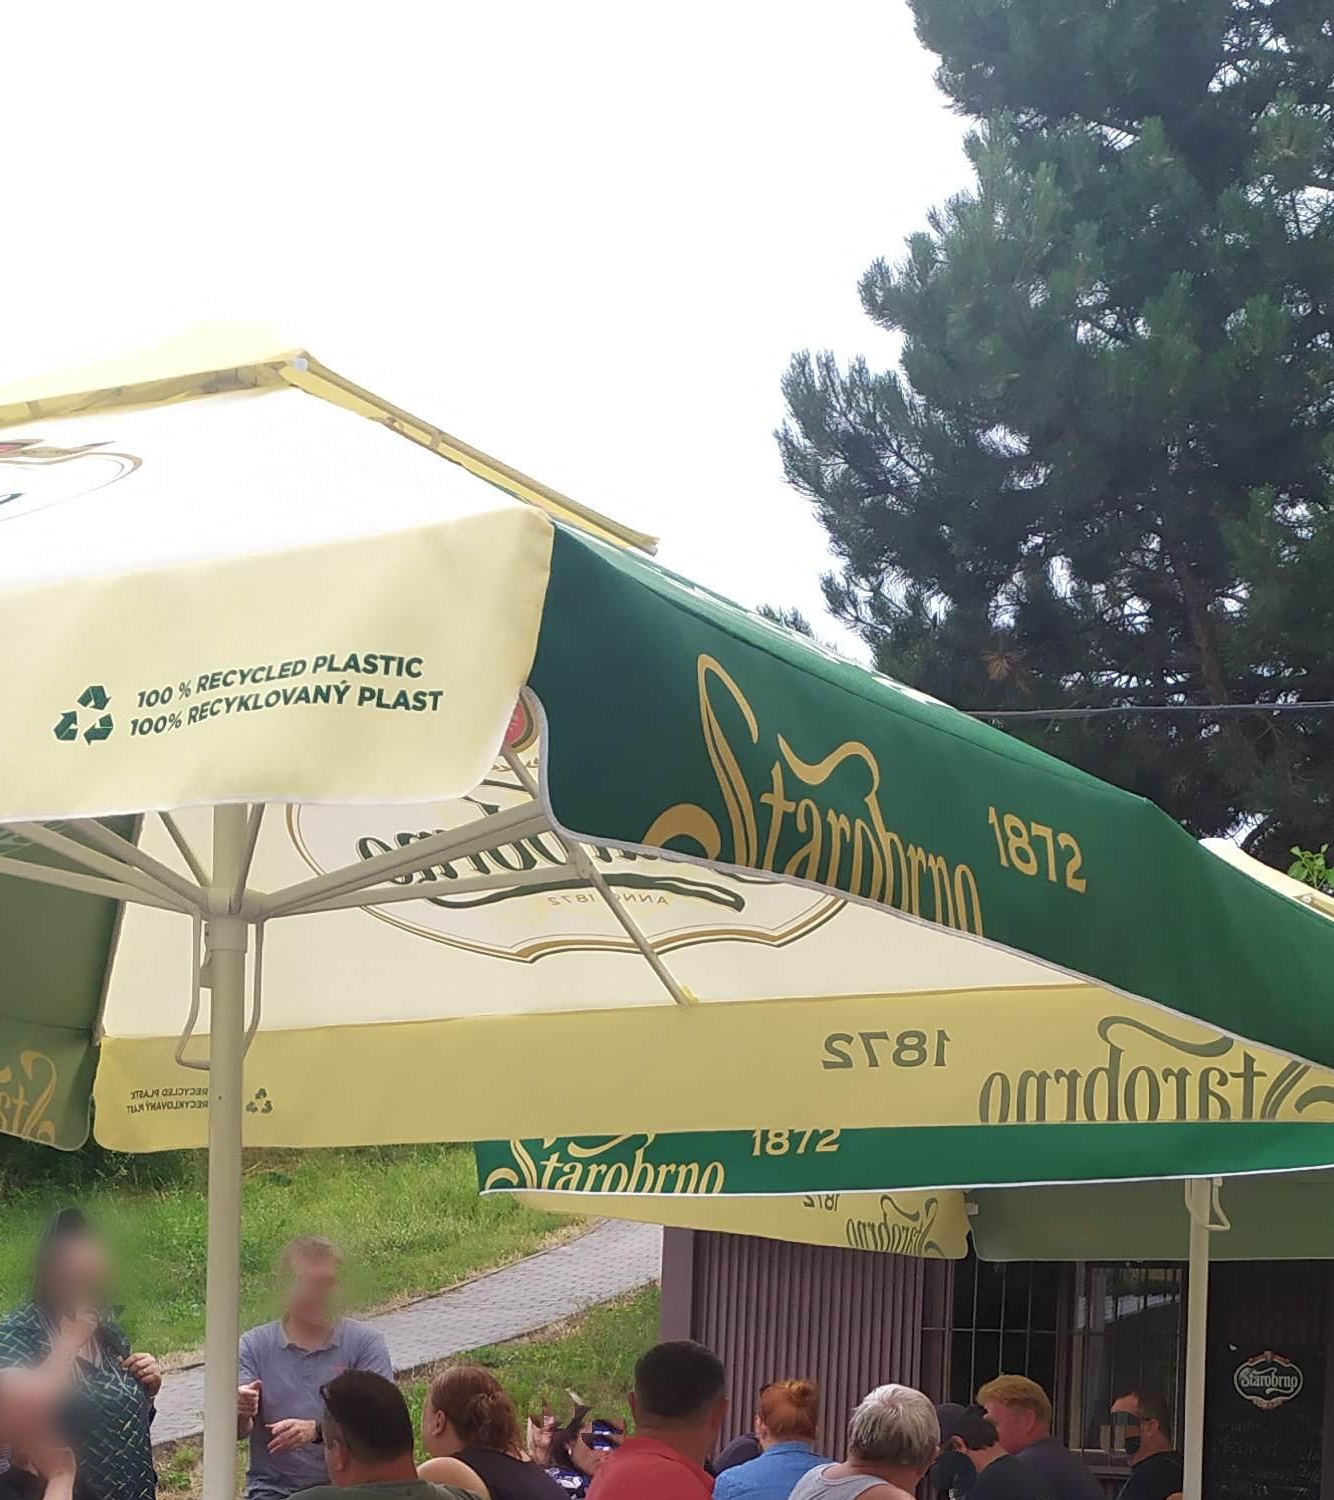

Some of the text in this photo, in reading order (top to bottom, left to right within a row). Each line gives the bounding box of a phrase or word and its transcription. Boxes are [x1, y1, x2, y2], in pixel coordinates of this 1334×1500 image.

[130, 680, 444, 736] 100% RECYKLOVANÝ PLAST
[137, 653, 424, 708] 100 % RECYCLED PLASTIC
[642, 654, 1086, 938] Starobrno 1872
[485, 1129, 841, 1193] Starobrno 1872
[1240, 1367, 1298, 1395] Starobrno
